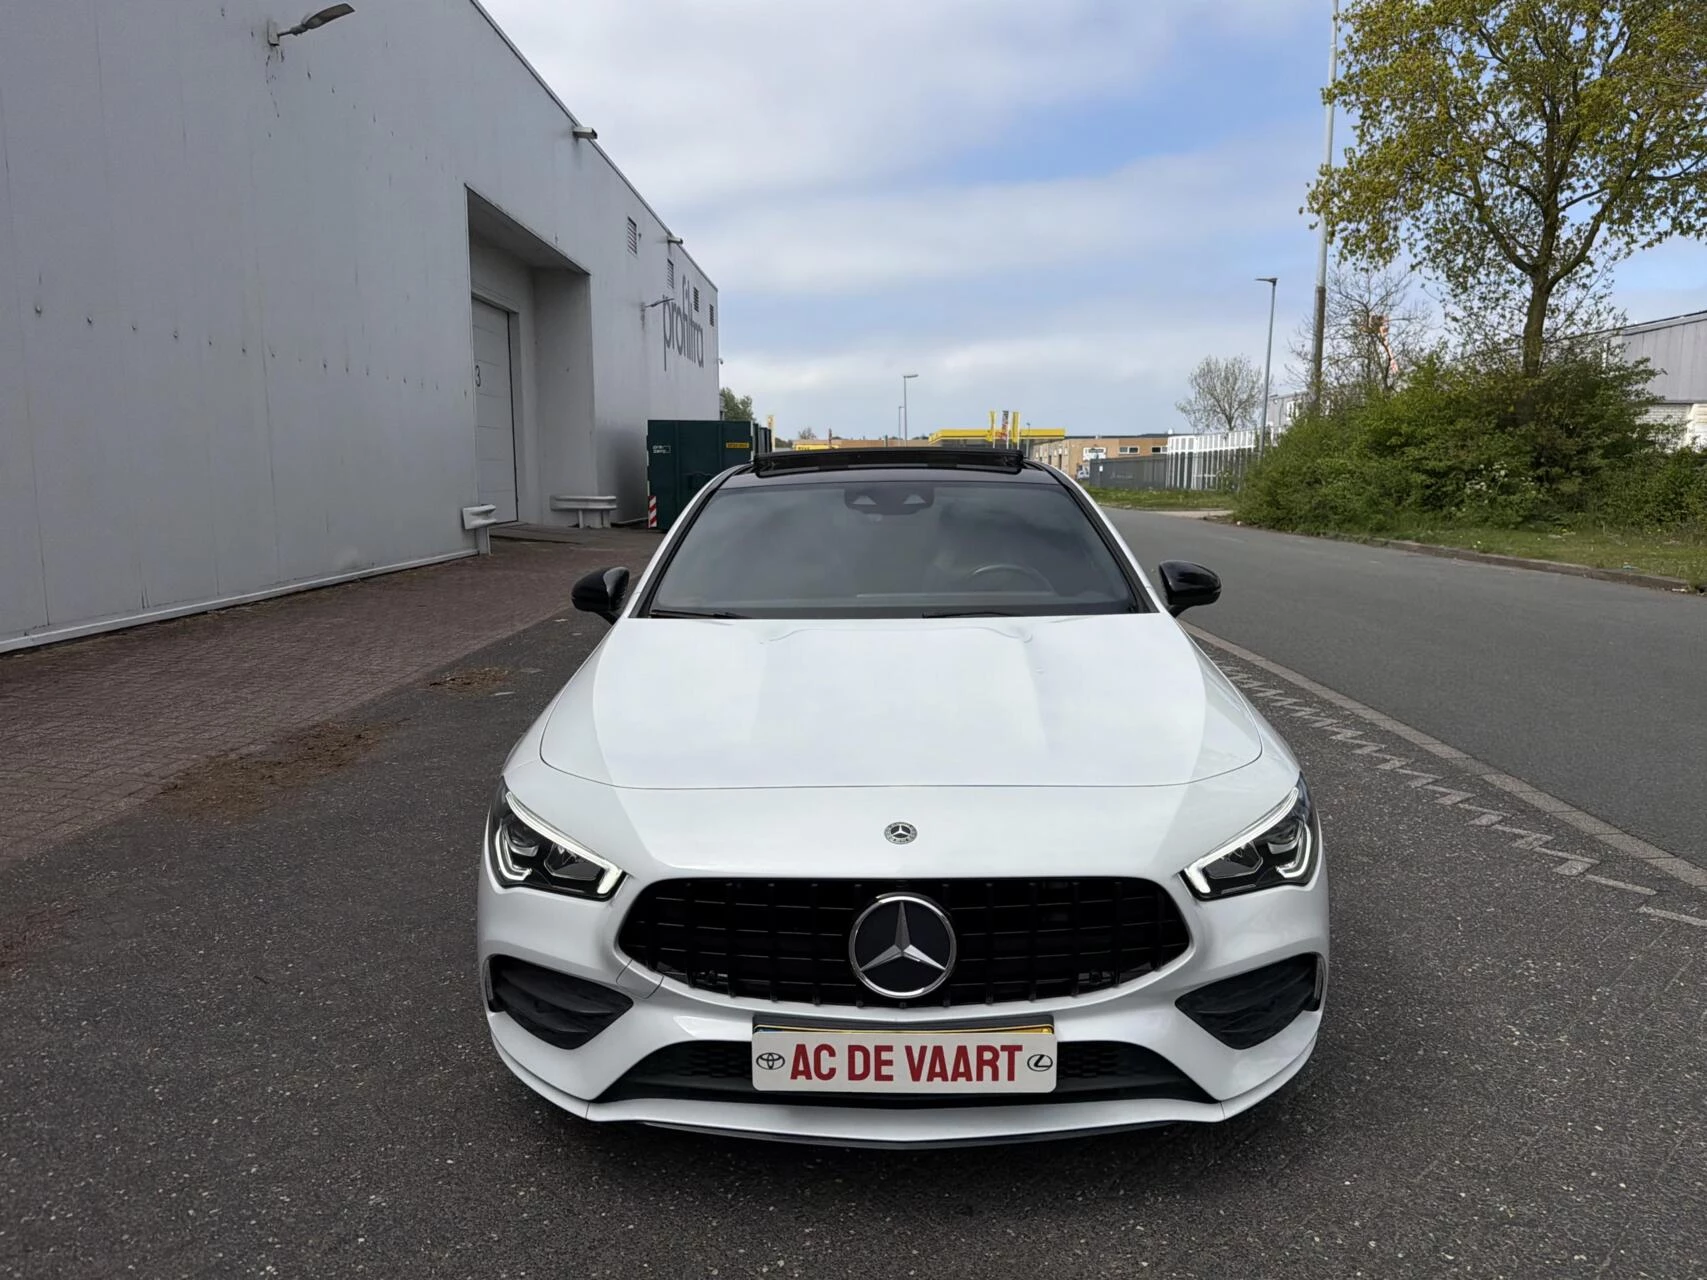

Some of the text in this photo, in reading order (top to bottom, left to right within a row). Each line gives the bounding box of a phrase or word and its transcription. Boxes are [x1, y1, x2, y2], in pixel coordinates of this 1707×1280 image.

[662, 274, 704, 372] profiltra
[475, 364, 482, 388] 3
[790, 1043, 1024, 1083] AC DE VAART
